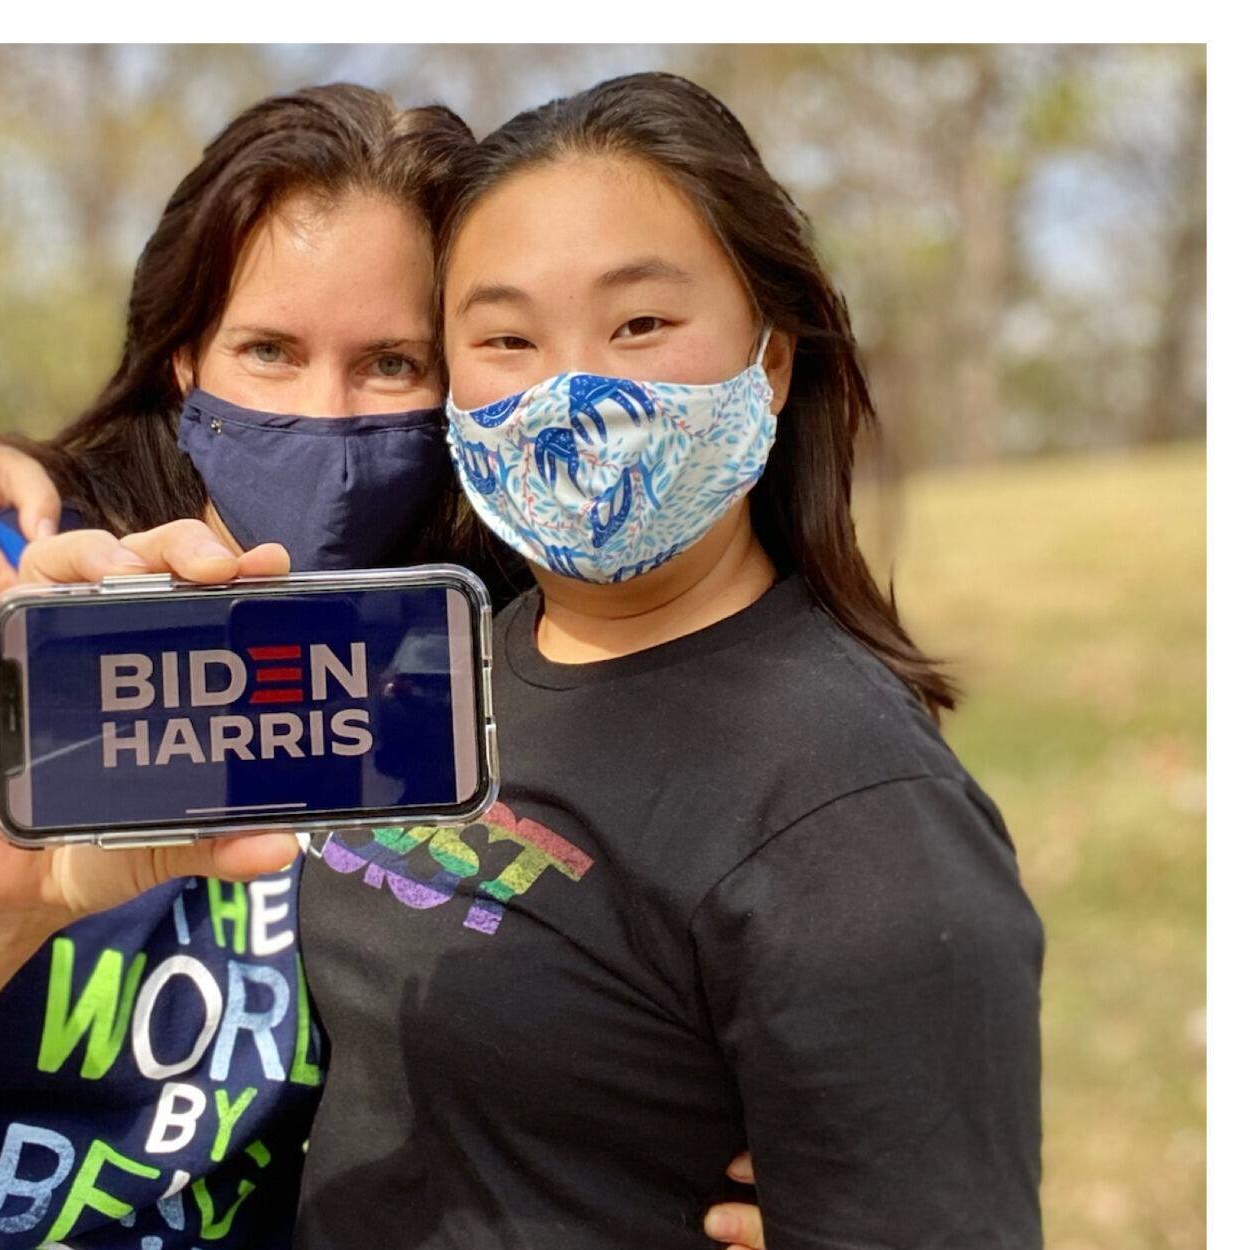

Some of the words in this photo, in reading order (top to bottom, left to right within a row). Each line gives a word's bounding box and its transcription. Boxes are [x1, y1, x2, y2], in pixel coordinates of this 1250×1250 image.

[100, 642, 369, 712] BIDEN
[103, 709, 373, 768] HARRIS
[37, 937, 322, 1086] WORL
[145, 1082, 258, 1162] BY
